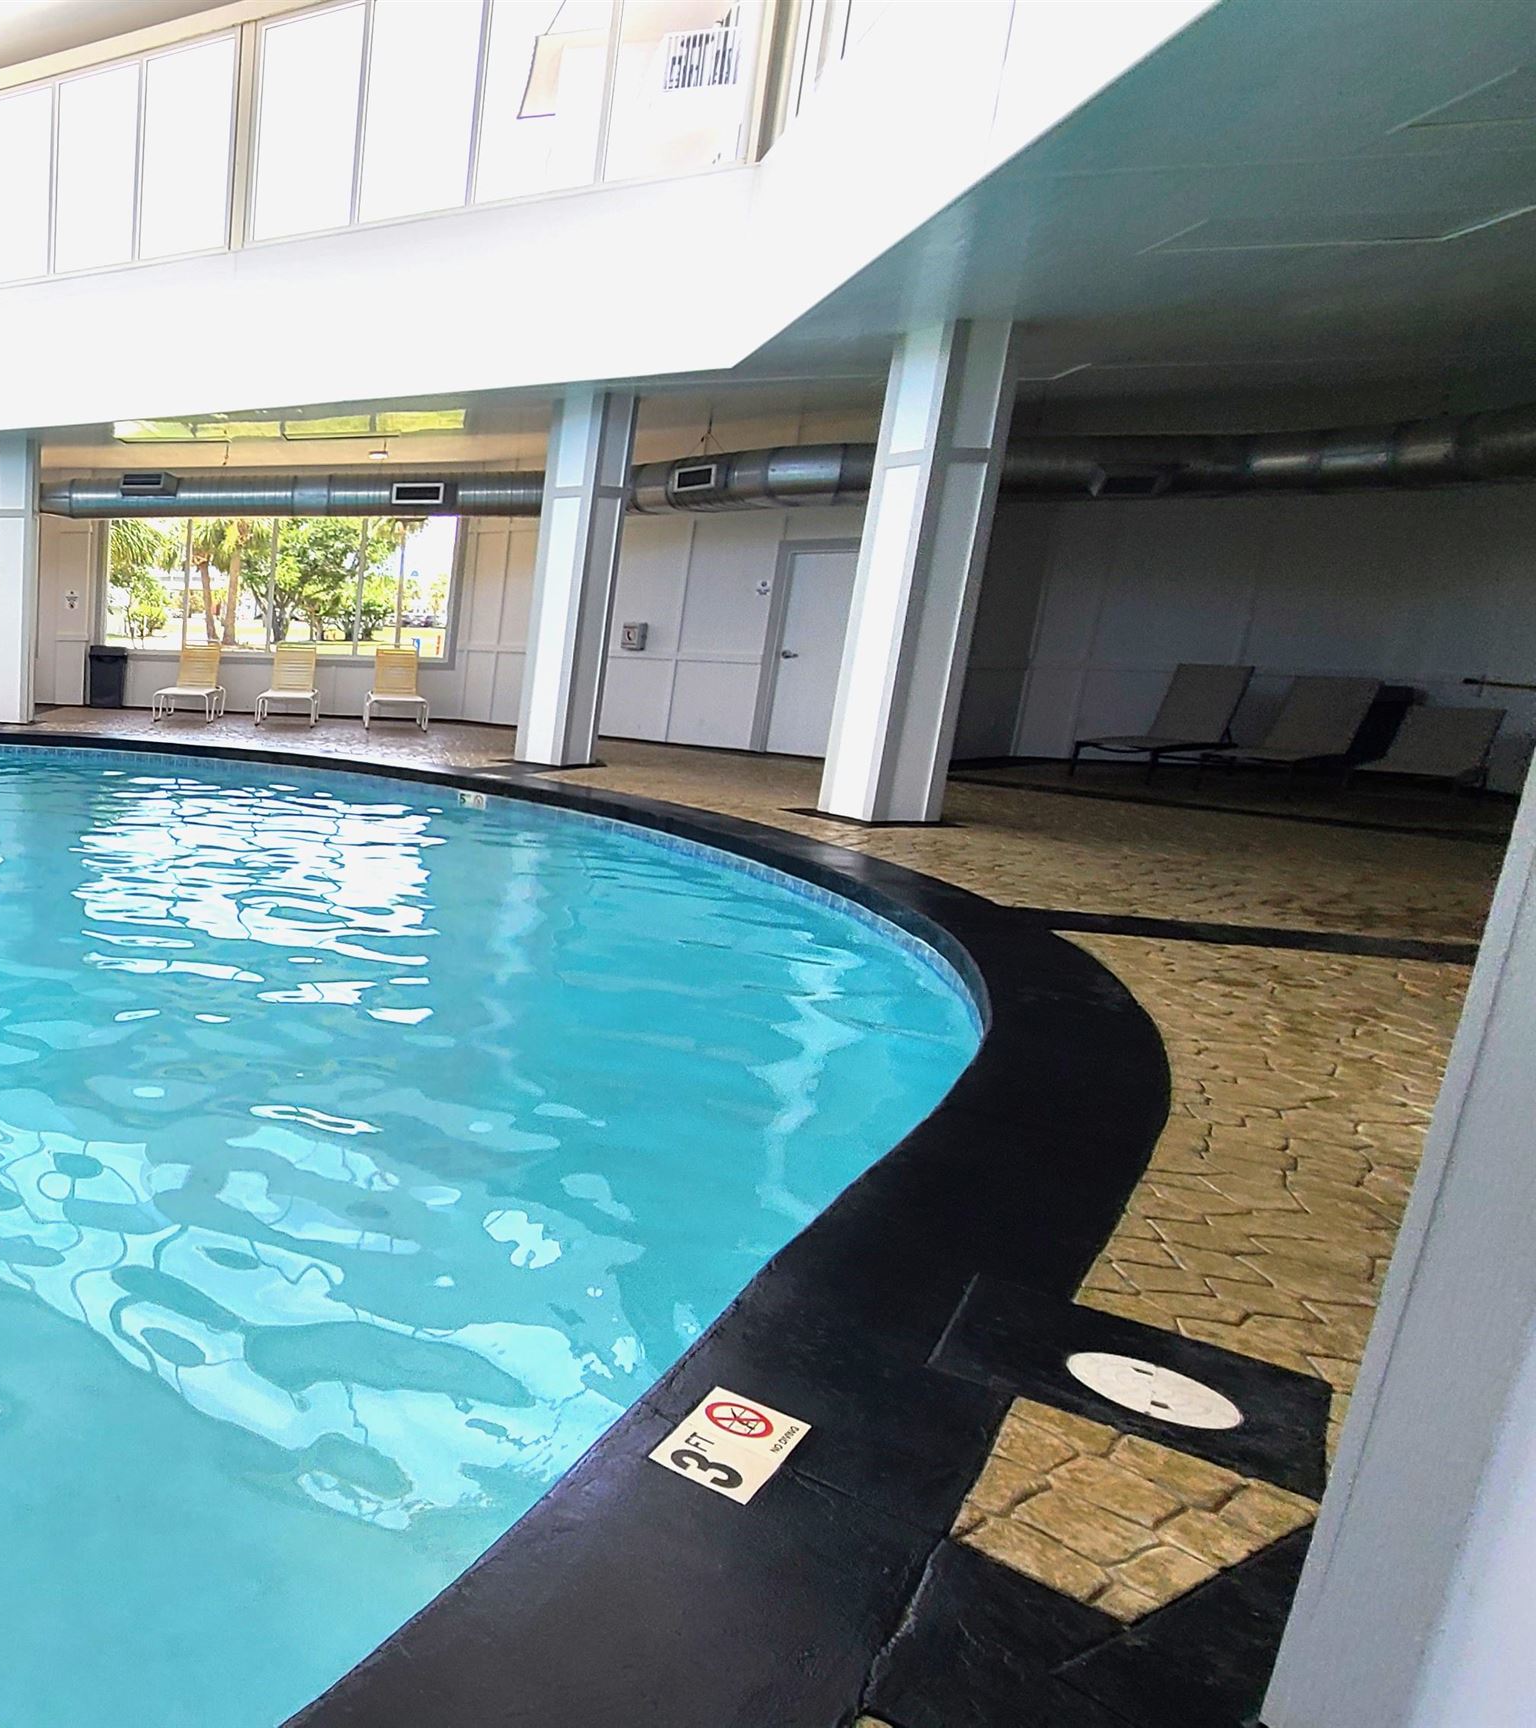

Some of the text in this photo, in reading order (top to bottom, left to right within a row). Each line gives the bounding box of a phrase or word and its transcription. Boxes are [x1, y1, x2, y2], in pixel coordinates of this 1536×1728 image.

[670, 1432, 743, 1489] 3 FT
[769, 1443, 784, 1453] NO
